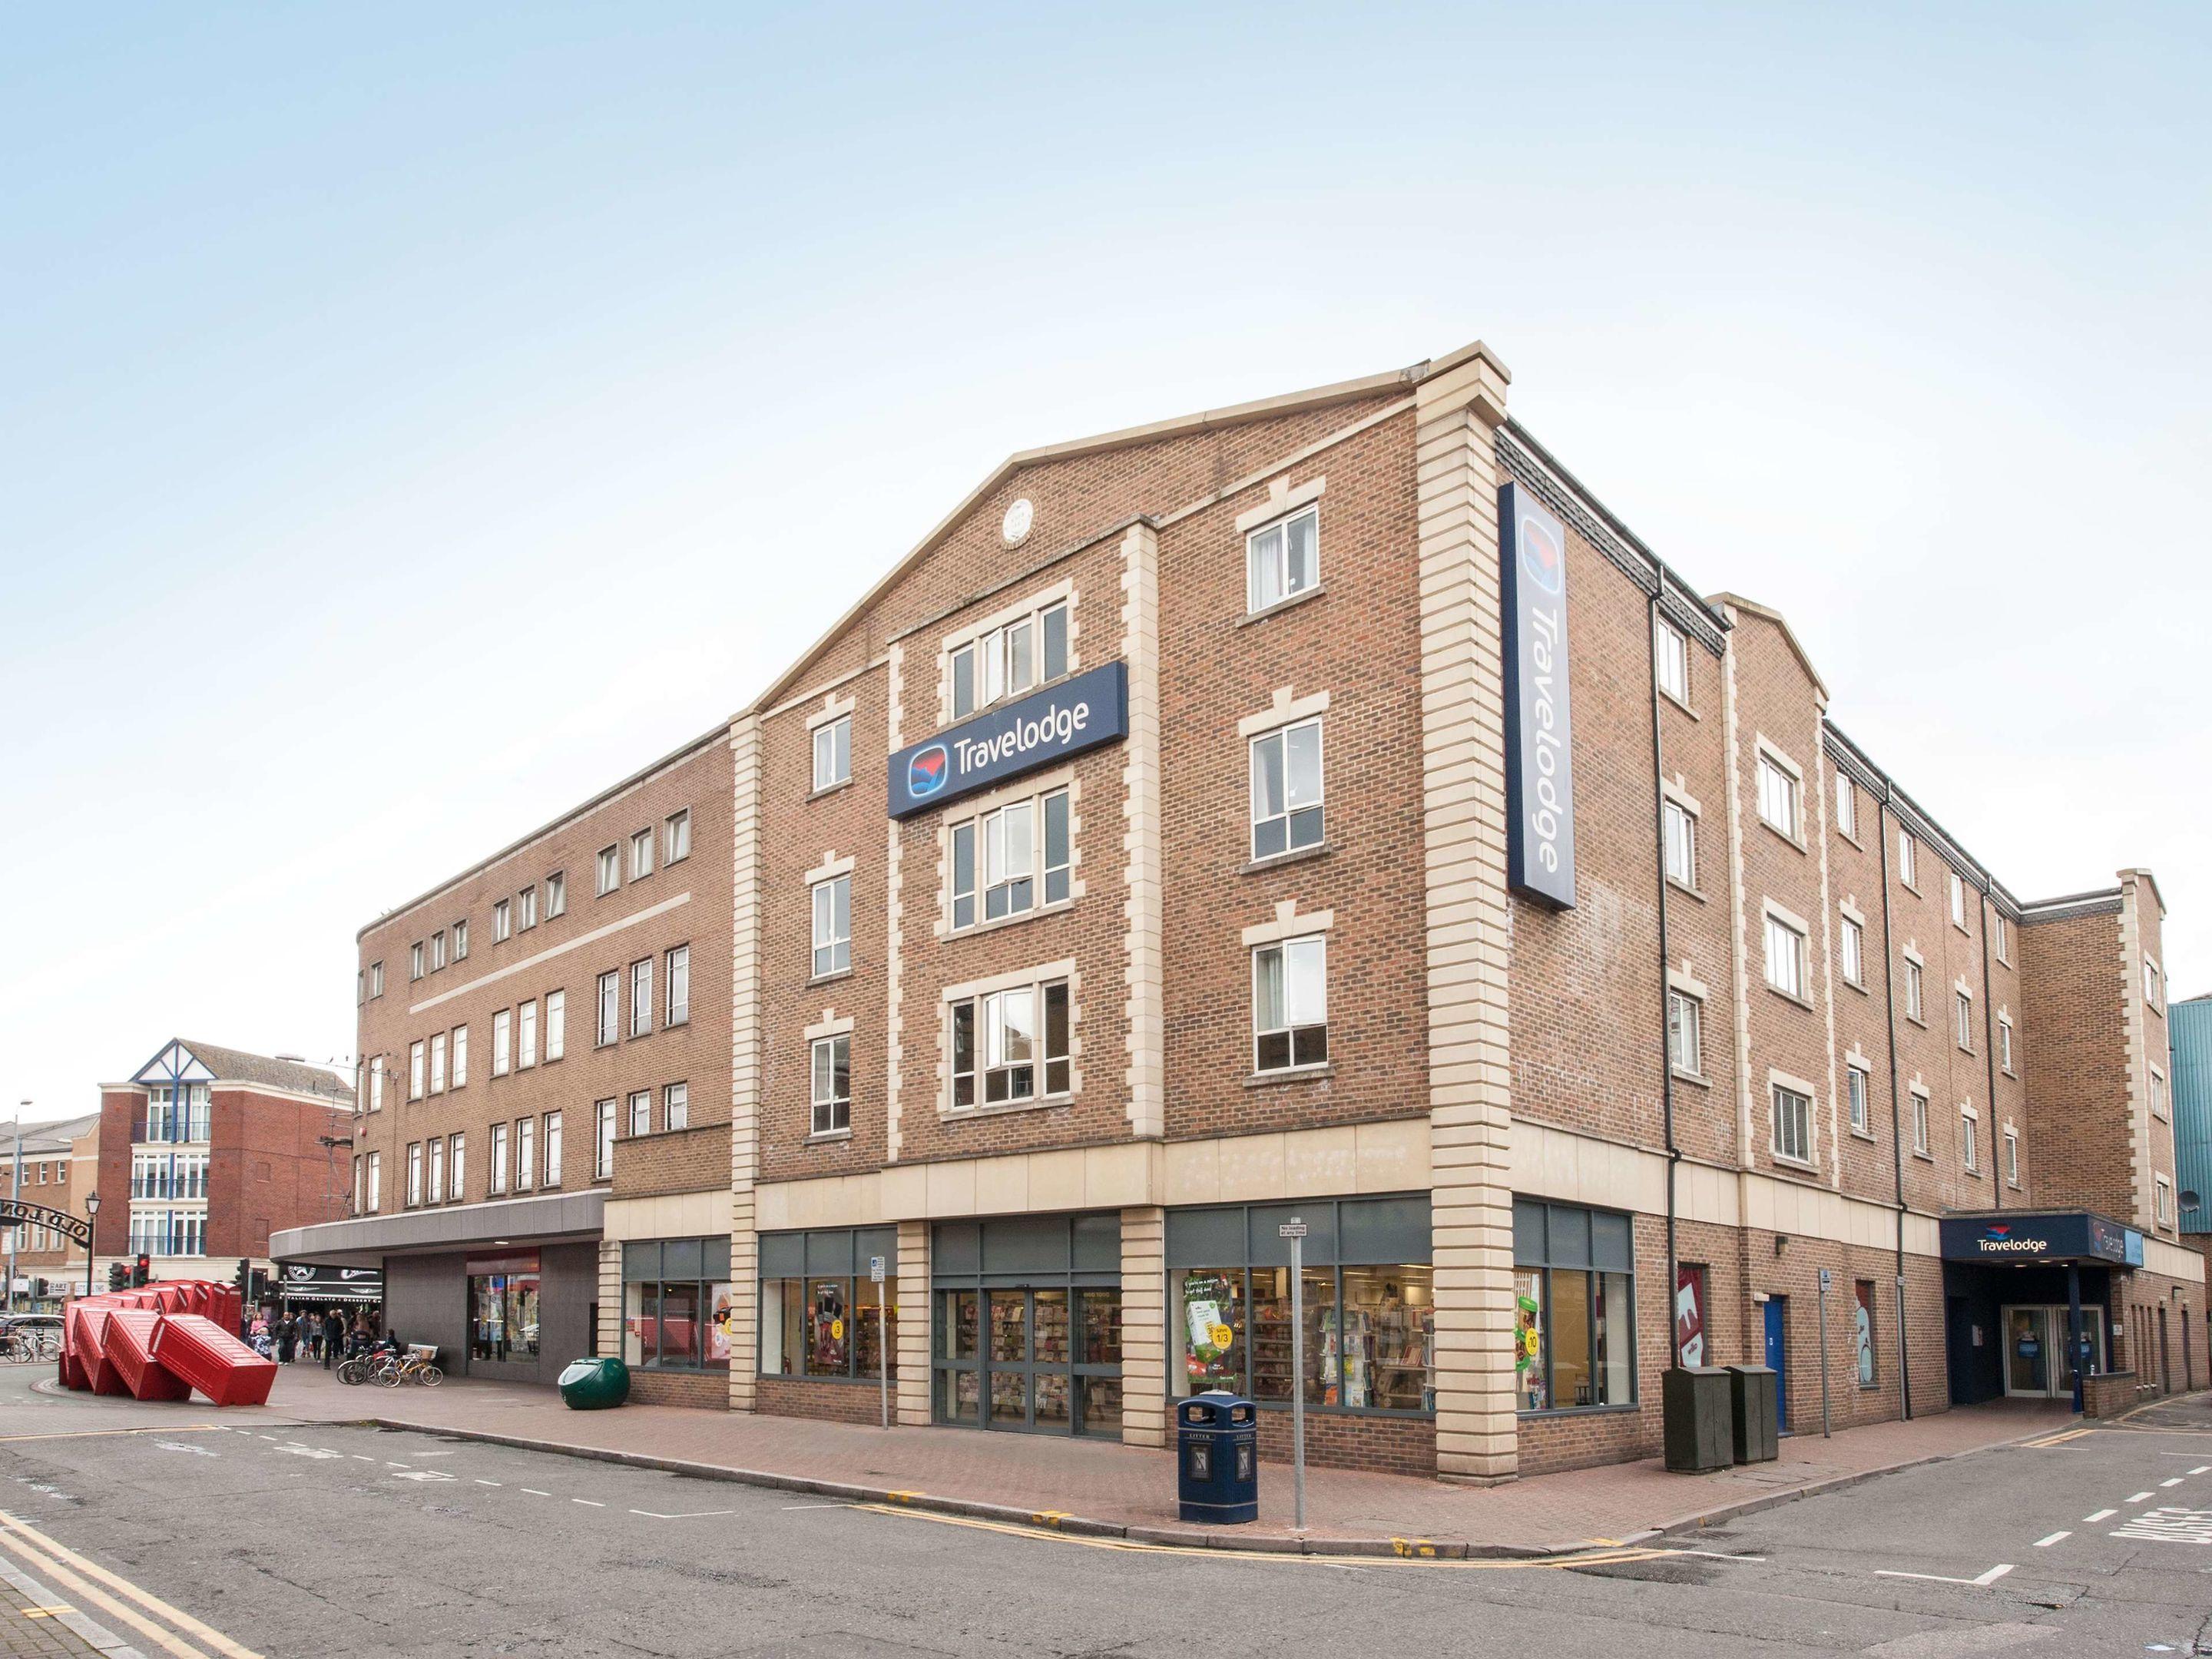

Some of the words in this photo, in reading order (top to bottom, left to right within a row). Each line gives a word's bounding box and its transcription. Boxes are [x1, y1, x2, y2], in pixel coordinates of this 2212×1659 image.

[954, 702, 1089, 774] Travelodge
[1532, 606, 1562, 873] Travelodge
[1977, 1238, 2048, 1253] Travelodge
[1217, 1333, 1229, 1343] 1/3
